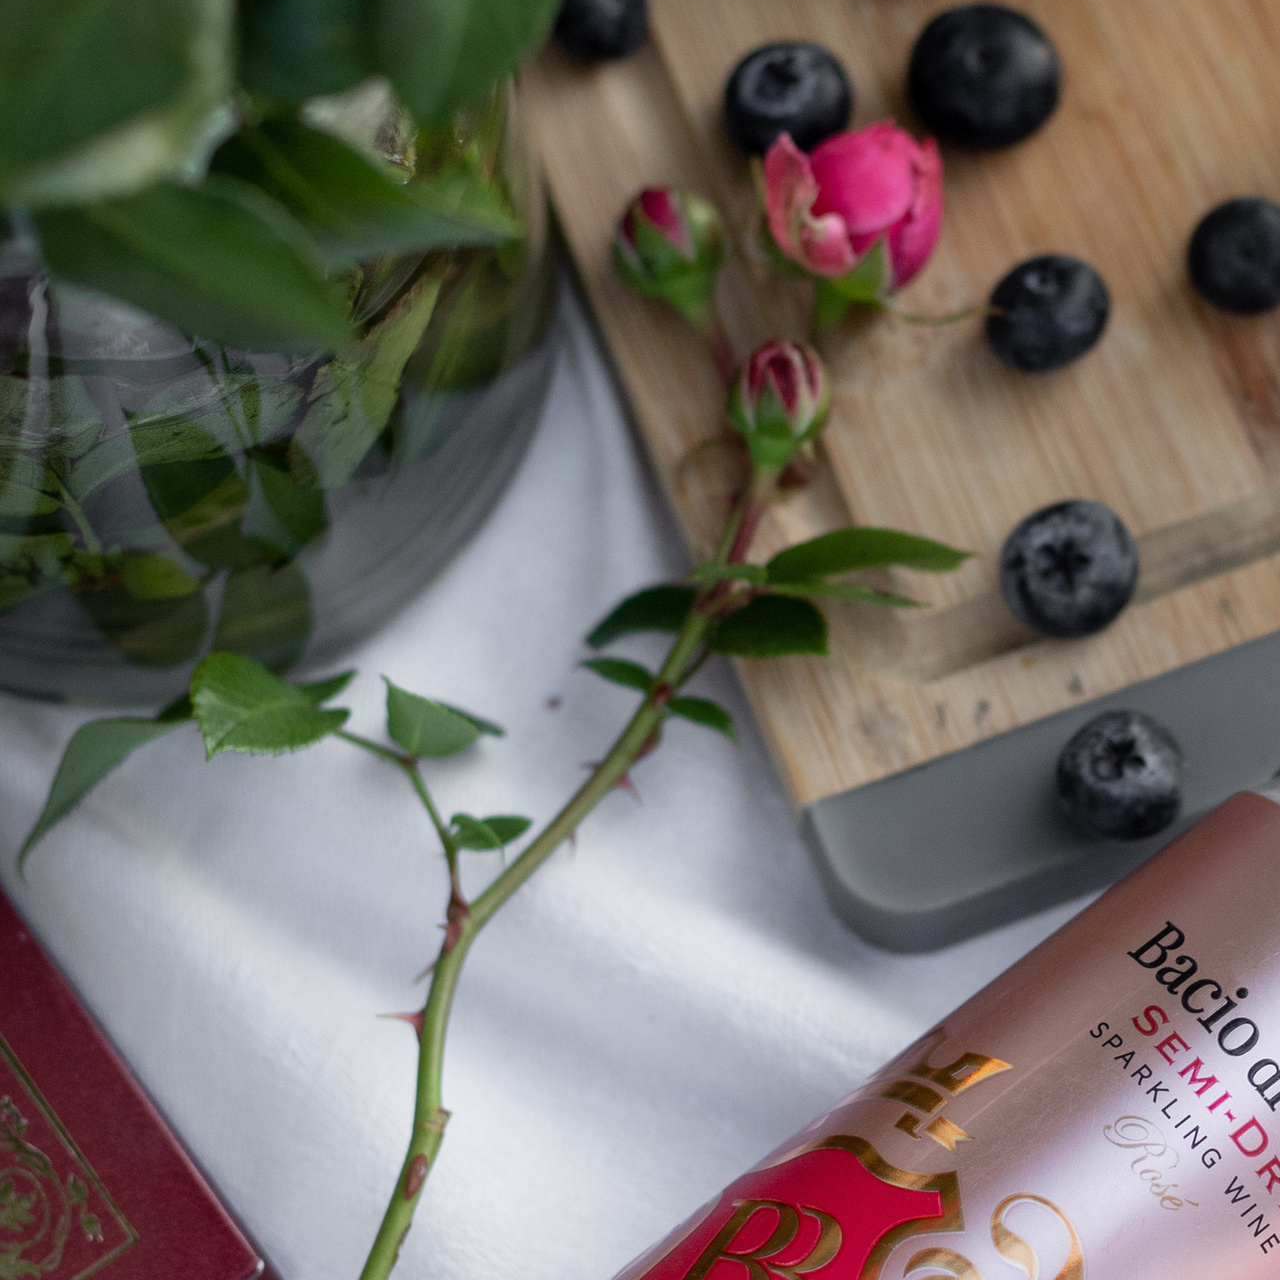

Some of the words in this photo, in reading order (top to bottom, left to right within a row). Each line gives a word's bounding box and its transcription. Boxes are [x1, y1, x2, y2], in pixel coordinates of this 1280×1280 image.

[1126, 920, 1260, 1057] Bacio
[1089, 1021, 1223, 1170] SPARKLING
[1224, 1176, 1280, 1254] WINE
[1102, 1114, 1200, 1211] Rosé
